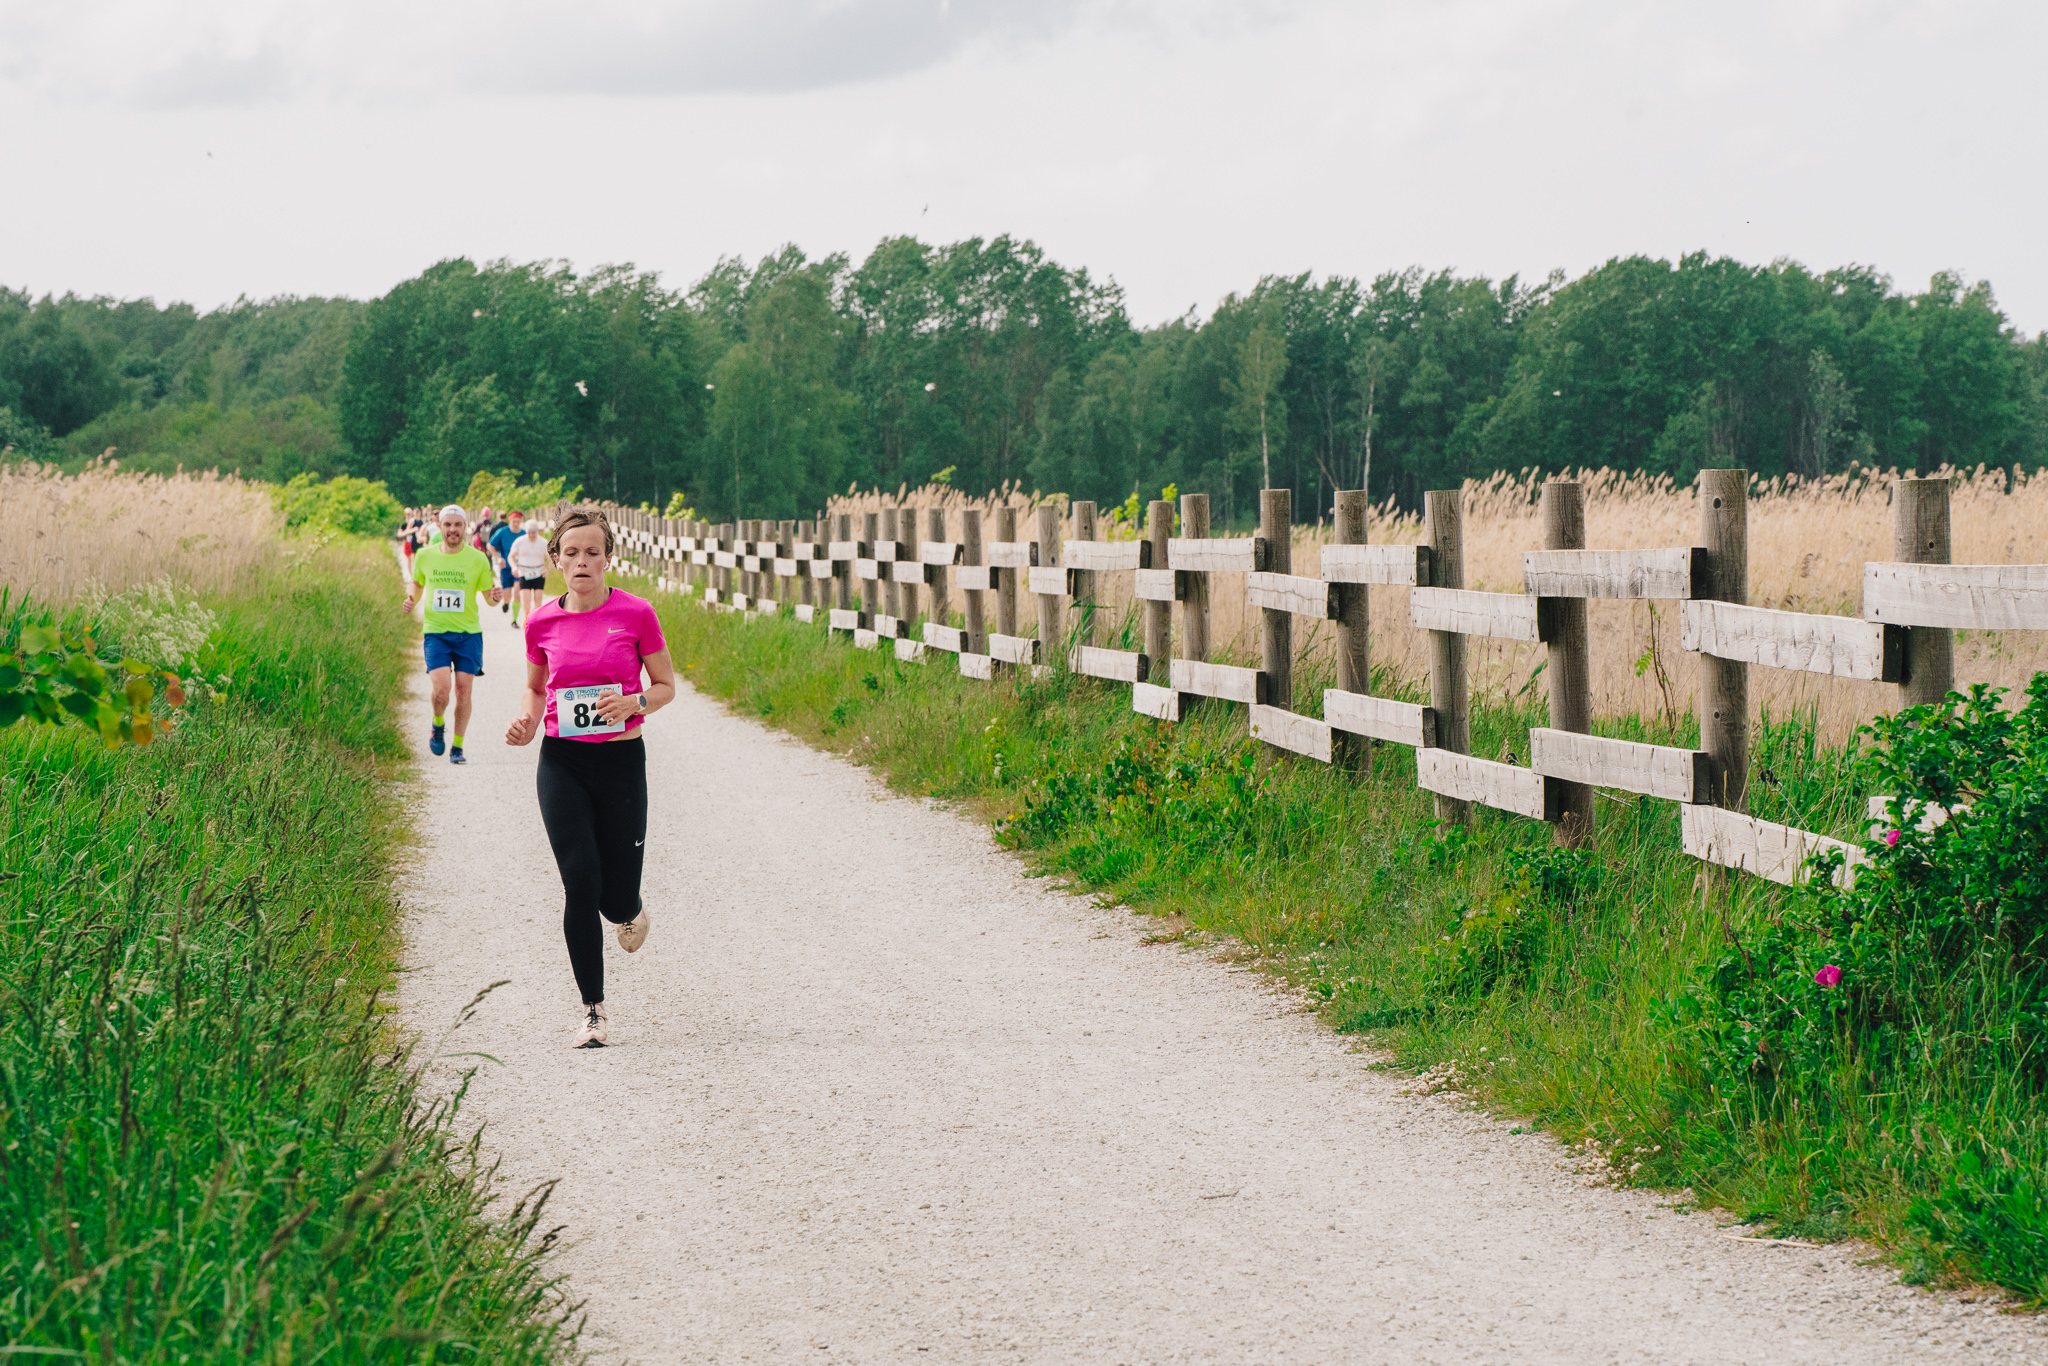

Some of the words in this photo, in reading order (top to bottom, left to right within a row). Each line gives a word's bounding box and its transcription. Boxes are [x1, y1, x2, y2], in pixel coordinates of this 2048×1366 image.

[433, 569, 465, 578] Running
[437, 596, 461, 608] 114
[574, 702, 608, 728] 82
